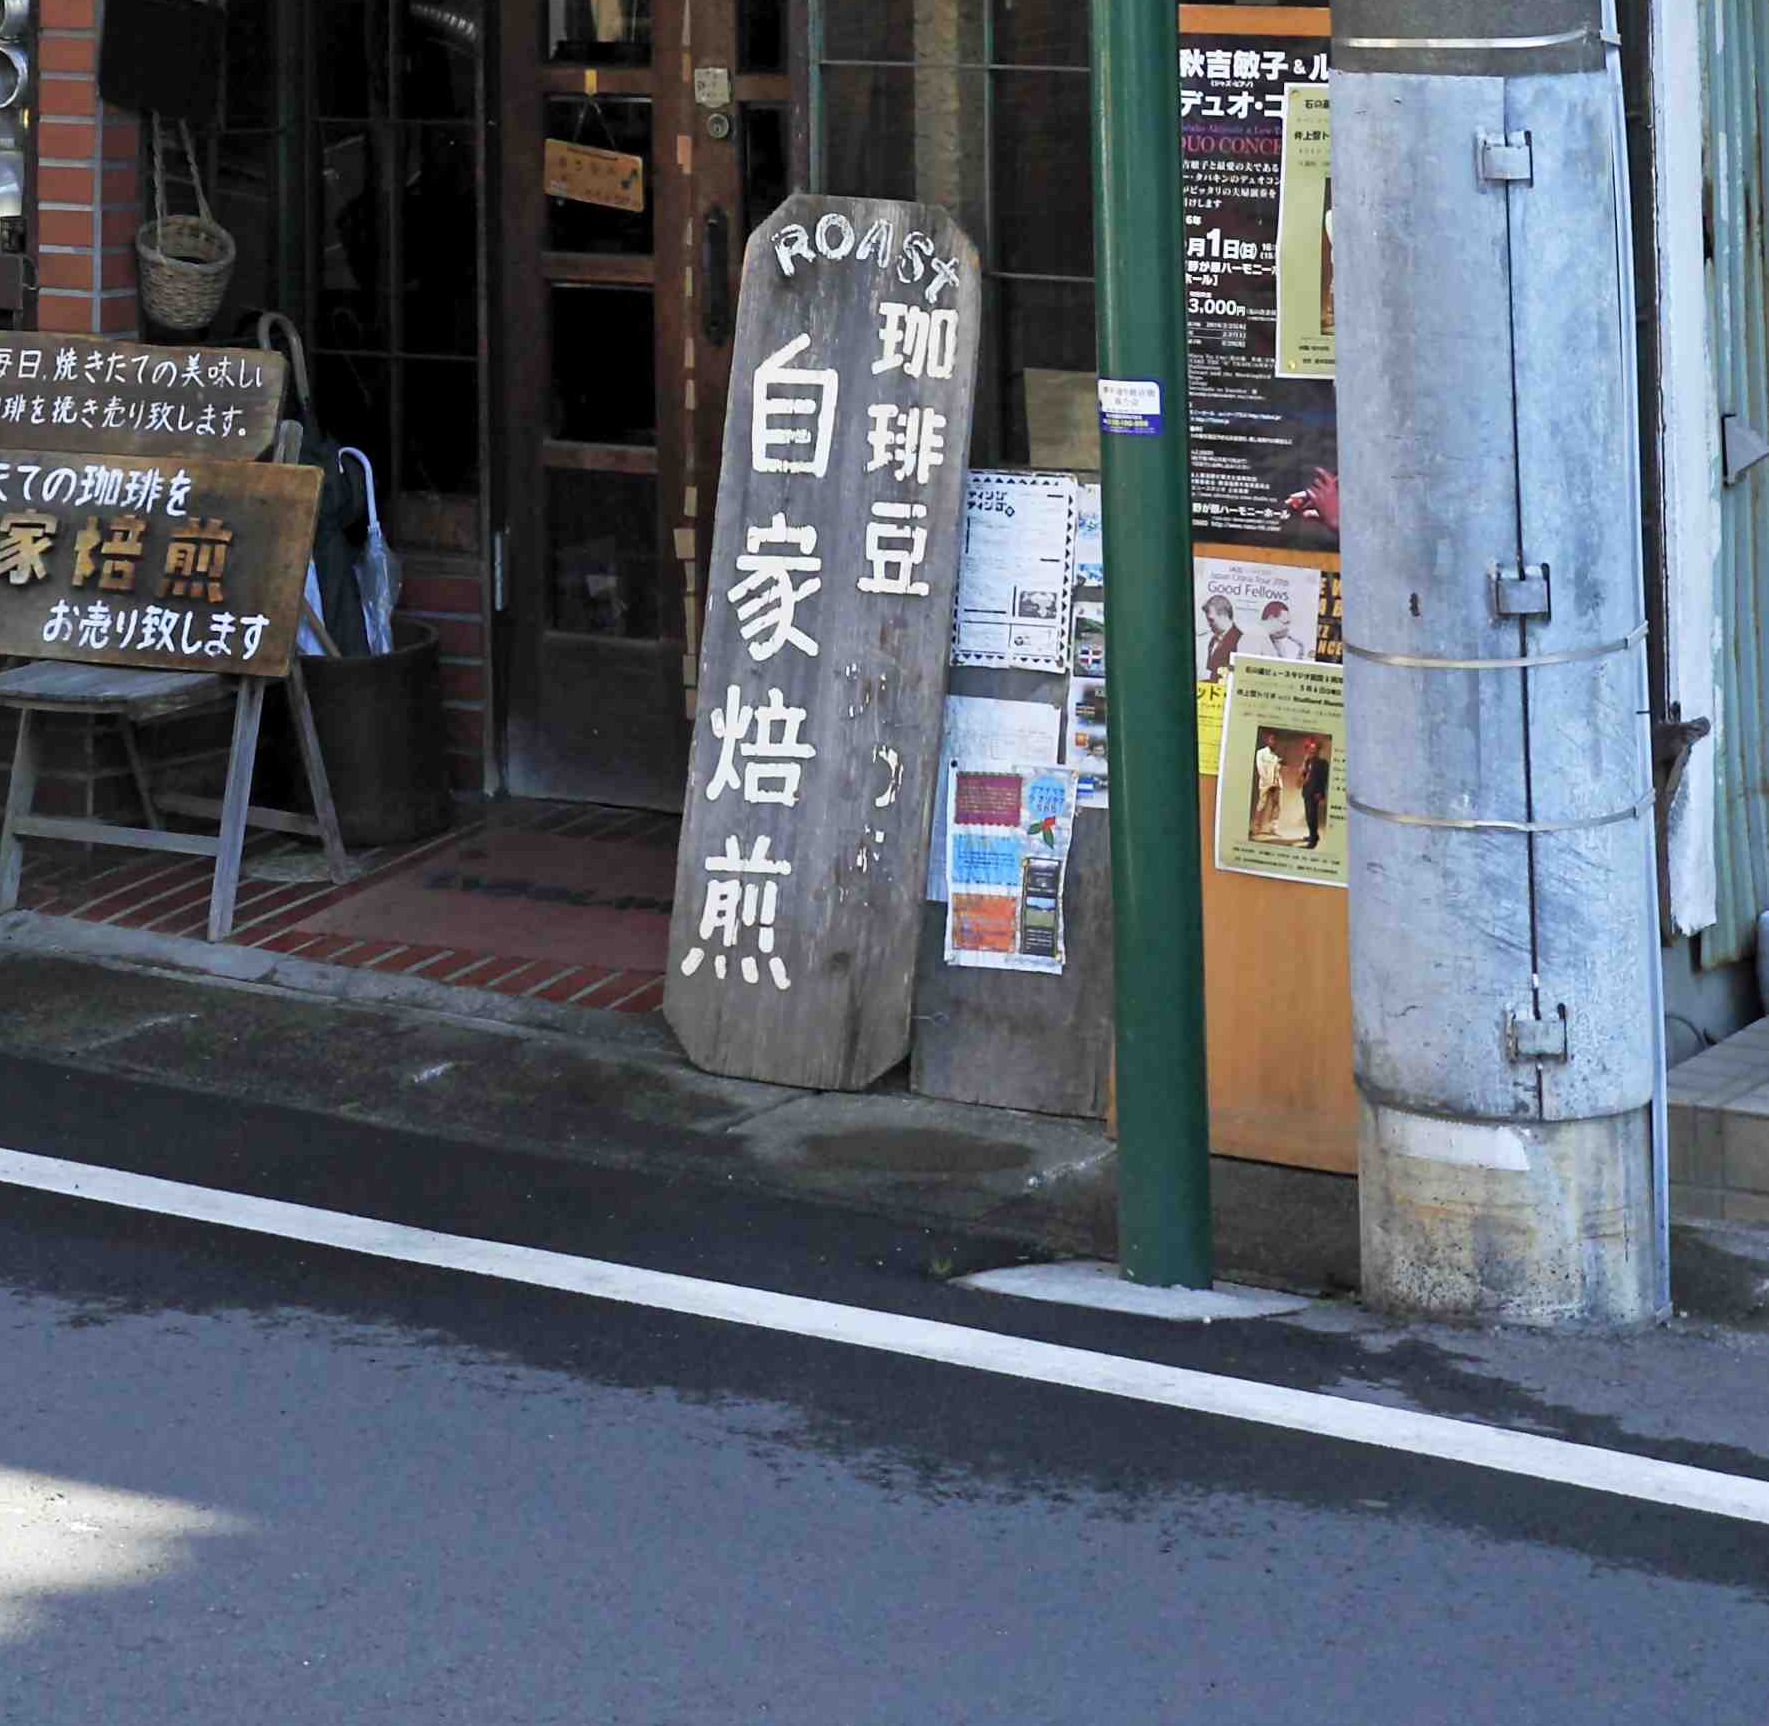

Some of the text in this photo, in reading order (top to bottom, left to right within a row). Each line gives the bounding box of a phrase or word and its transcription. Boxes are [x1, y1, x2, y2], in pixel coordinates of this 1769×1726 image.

[856, 301, 961, 598] 珈琲豆
[42, 598, 271, 660] お売り致します
[681, 332, 839, 990] 自家焙煎
[1207, 580, 1290, 601] Good Fellows
